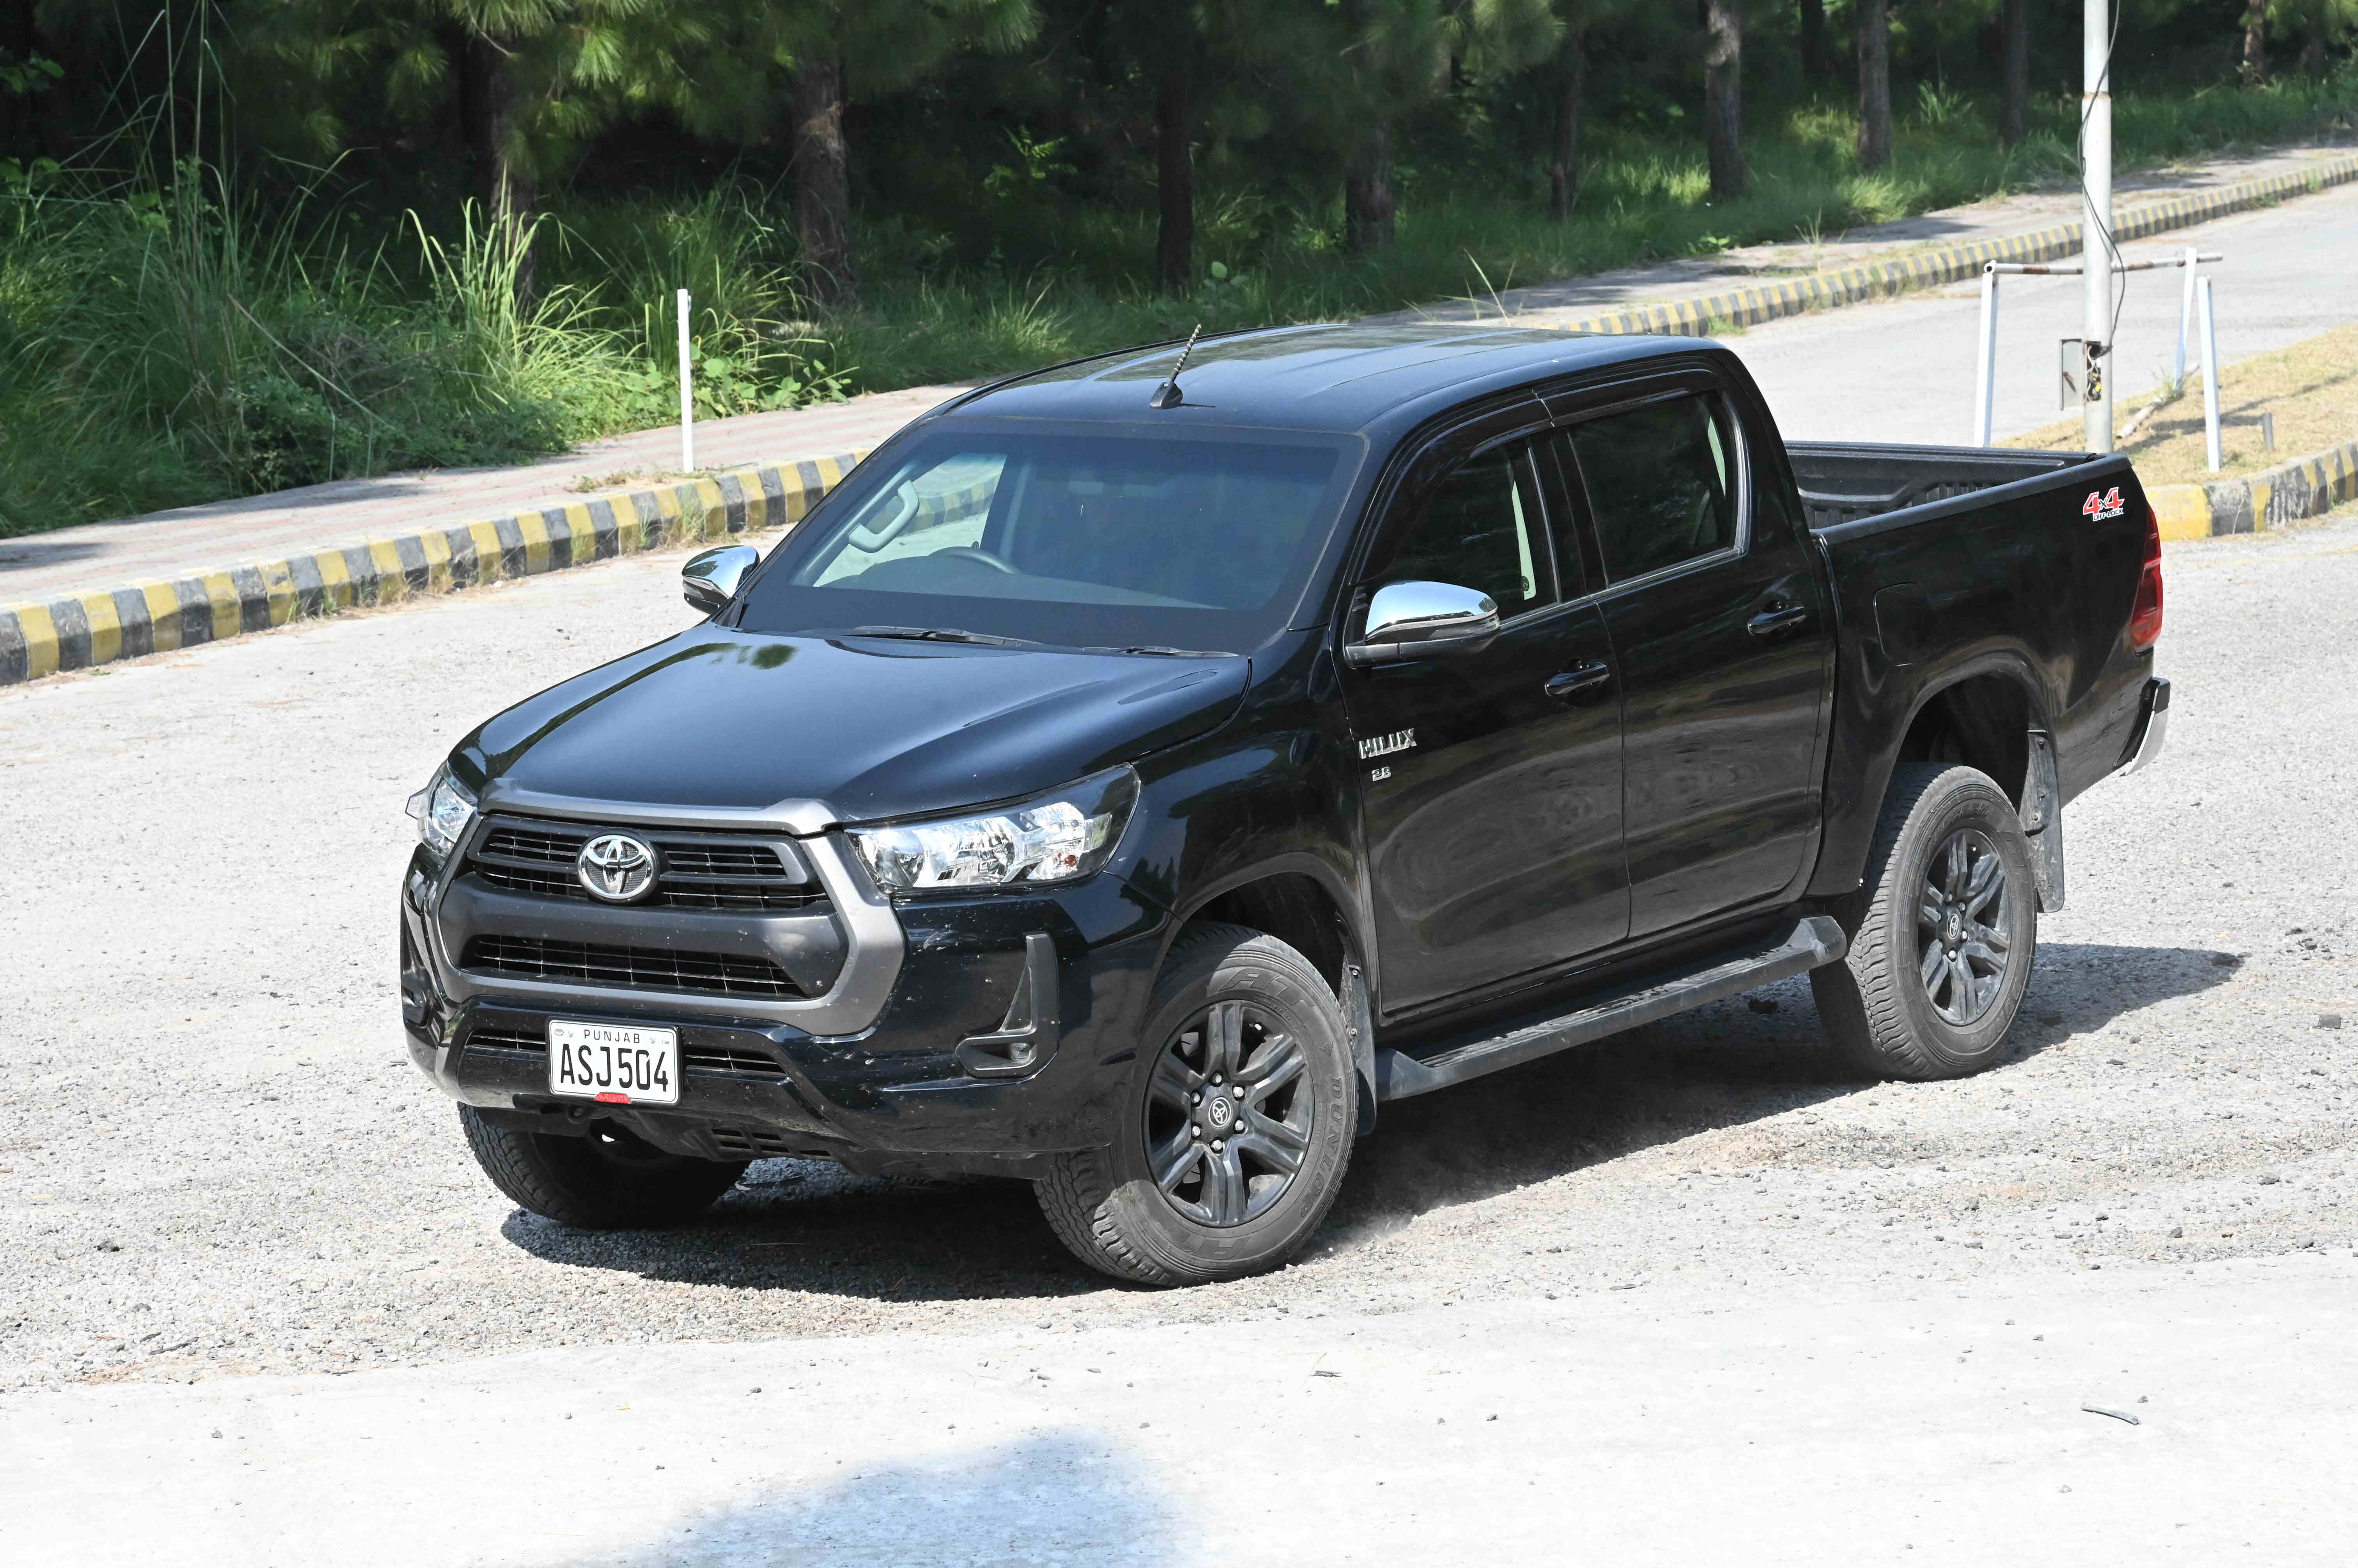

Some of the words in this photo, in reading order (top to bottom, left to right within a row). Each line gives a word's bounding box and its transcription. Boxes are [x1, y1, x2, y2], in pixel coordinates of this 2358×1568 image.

[2092, 507, 2124, 521] DIFF-LOCK
[1359, 728, 1417, 759] HILUX
[584, 1029, 640, 1043] PUNJAB
[1301, 1075, 1343, 1218] DUNLOP
